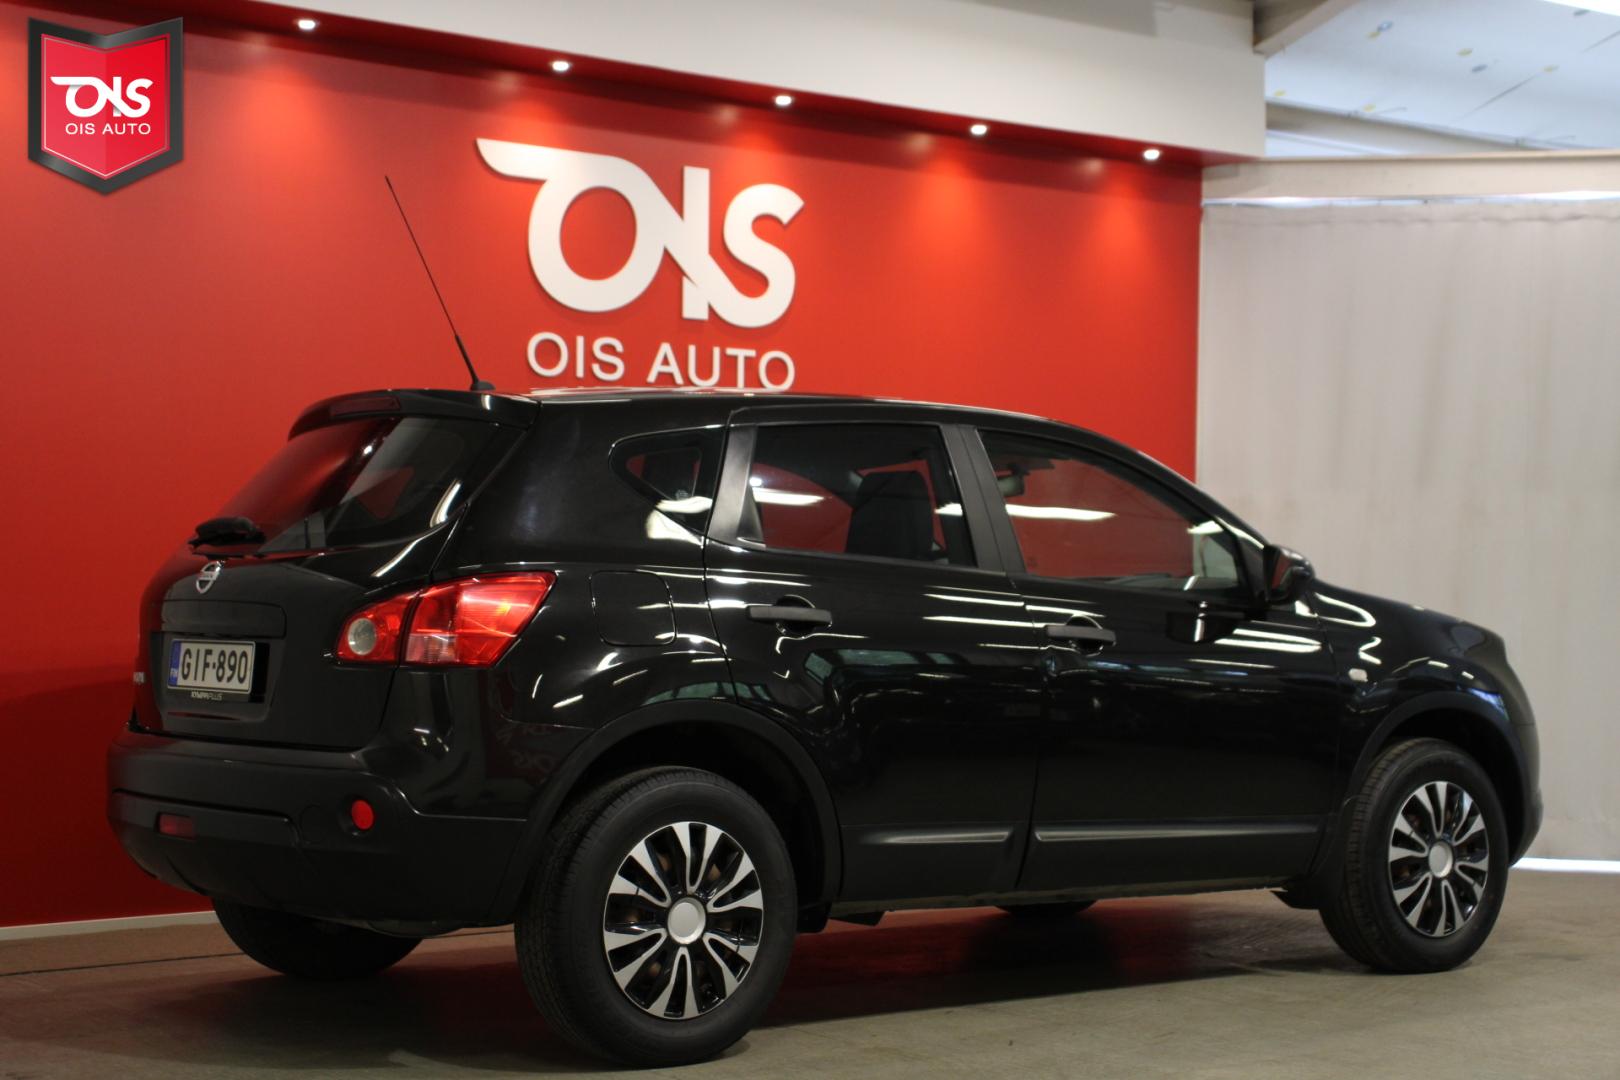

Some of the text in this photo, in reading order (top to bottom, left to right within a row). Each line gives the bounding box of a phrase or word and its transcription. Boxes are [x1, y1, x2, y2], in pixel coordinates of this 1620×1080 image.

[475, 137, 804, 328] OIS
[526, 332, 796, 392] OIS AUTO
[181, 648, 249, 684] GIF-890
